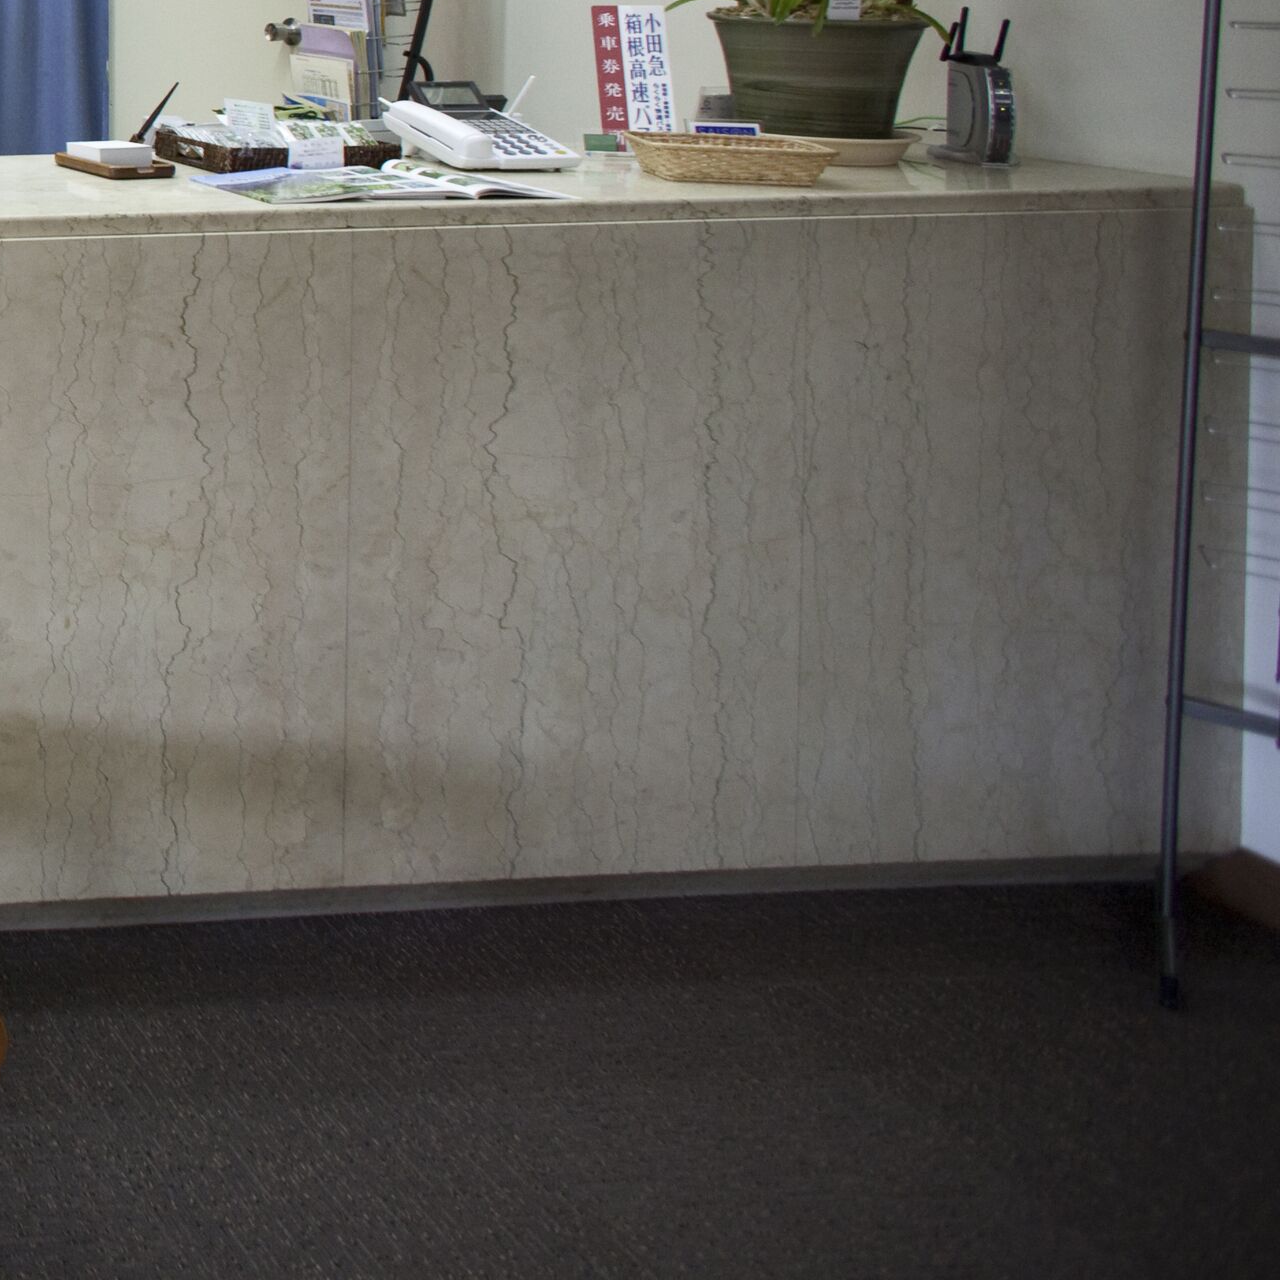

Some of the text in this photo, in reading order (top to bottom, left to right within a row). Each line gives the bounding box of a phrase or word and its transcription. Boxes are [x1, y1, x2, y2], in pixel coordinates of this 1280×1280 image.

[625, 13, 652, 132] 箱根高速バ
[645, 12, 666, 77] 小田急
